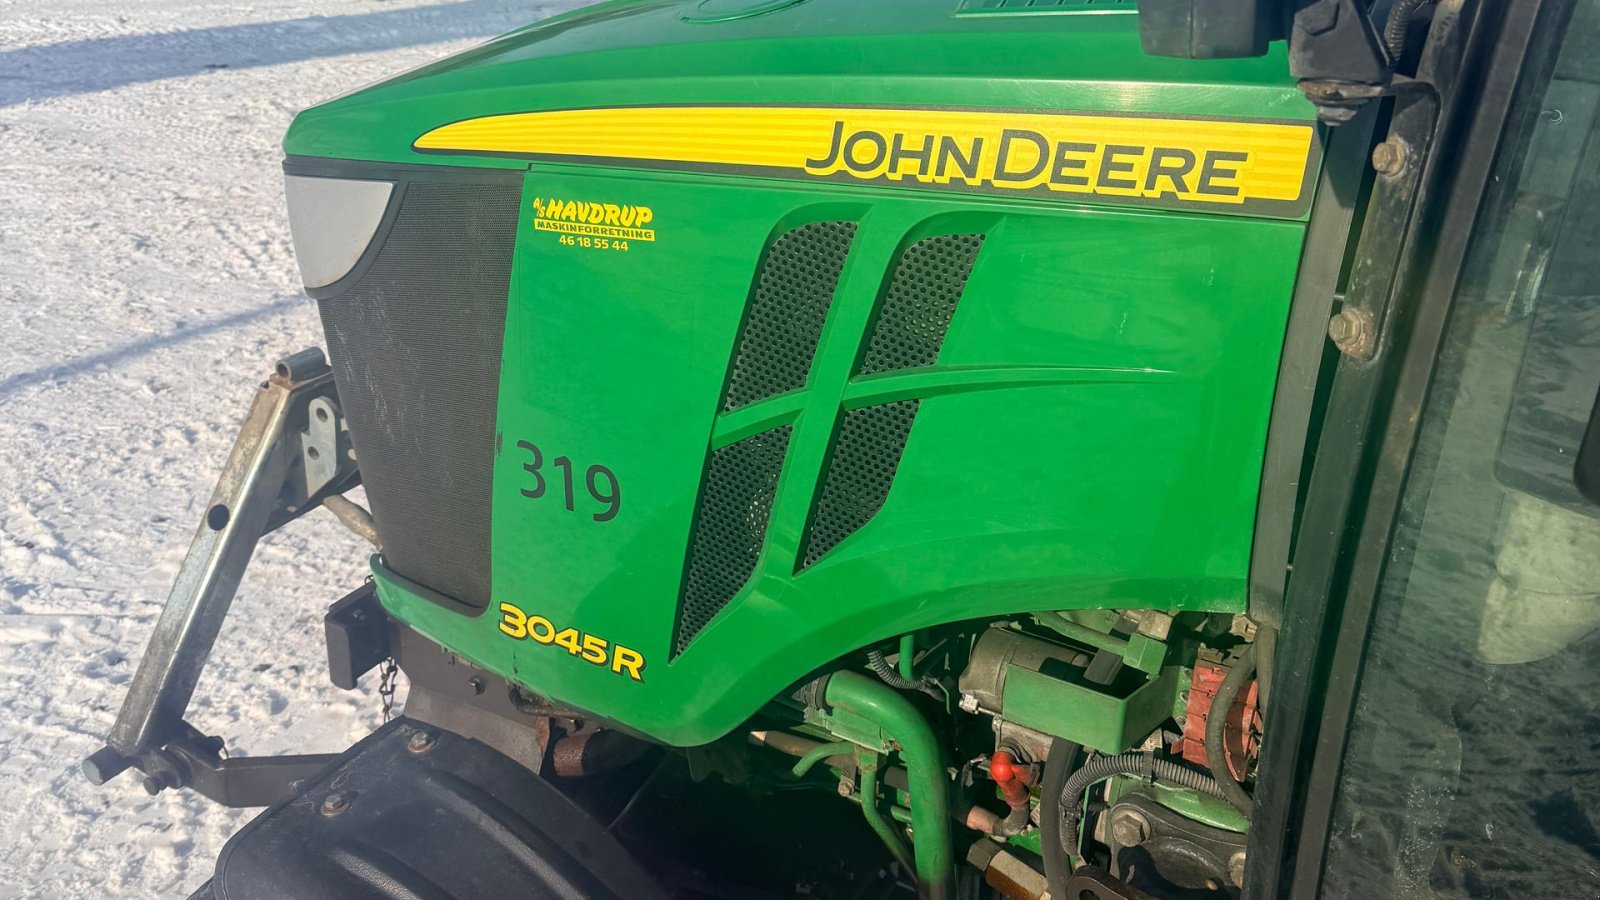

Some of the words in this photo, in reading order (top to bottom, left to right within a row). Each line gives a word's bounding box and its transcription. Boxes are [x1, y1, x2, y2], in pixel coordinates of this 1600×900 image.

[805, 121, 984, 178] JOHN
[995, 129, 1248, 195] DEERE
[546, 199, 653, 228] HAVDRUP
[537, 221, 652, 239] MASKINFORRETNING
[559, 235, 574, 246] 46
[577, 237, 591, 248] 18
[594, 238, 609, 250] 55
[612, 241, 628, 252] 44
[517, 440, 621, 522] 319
